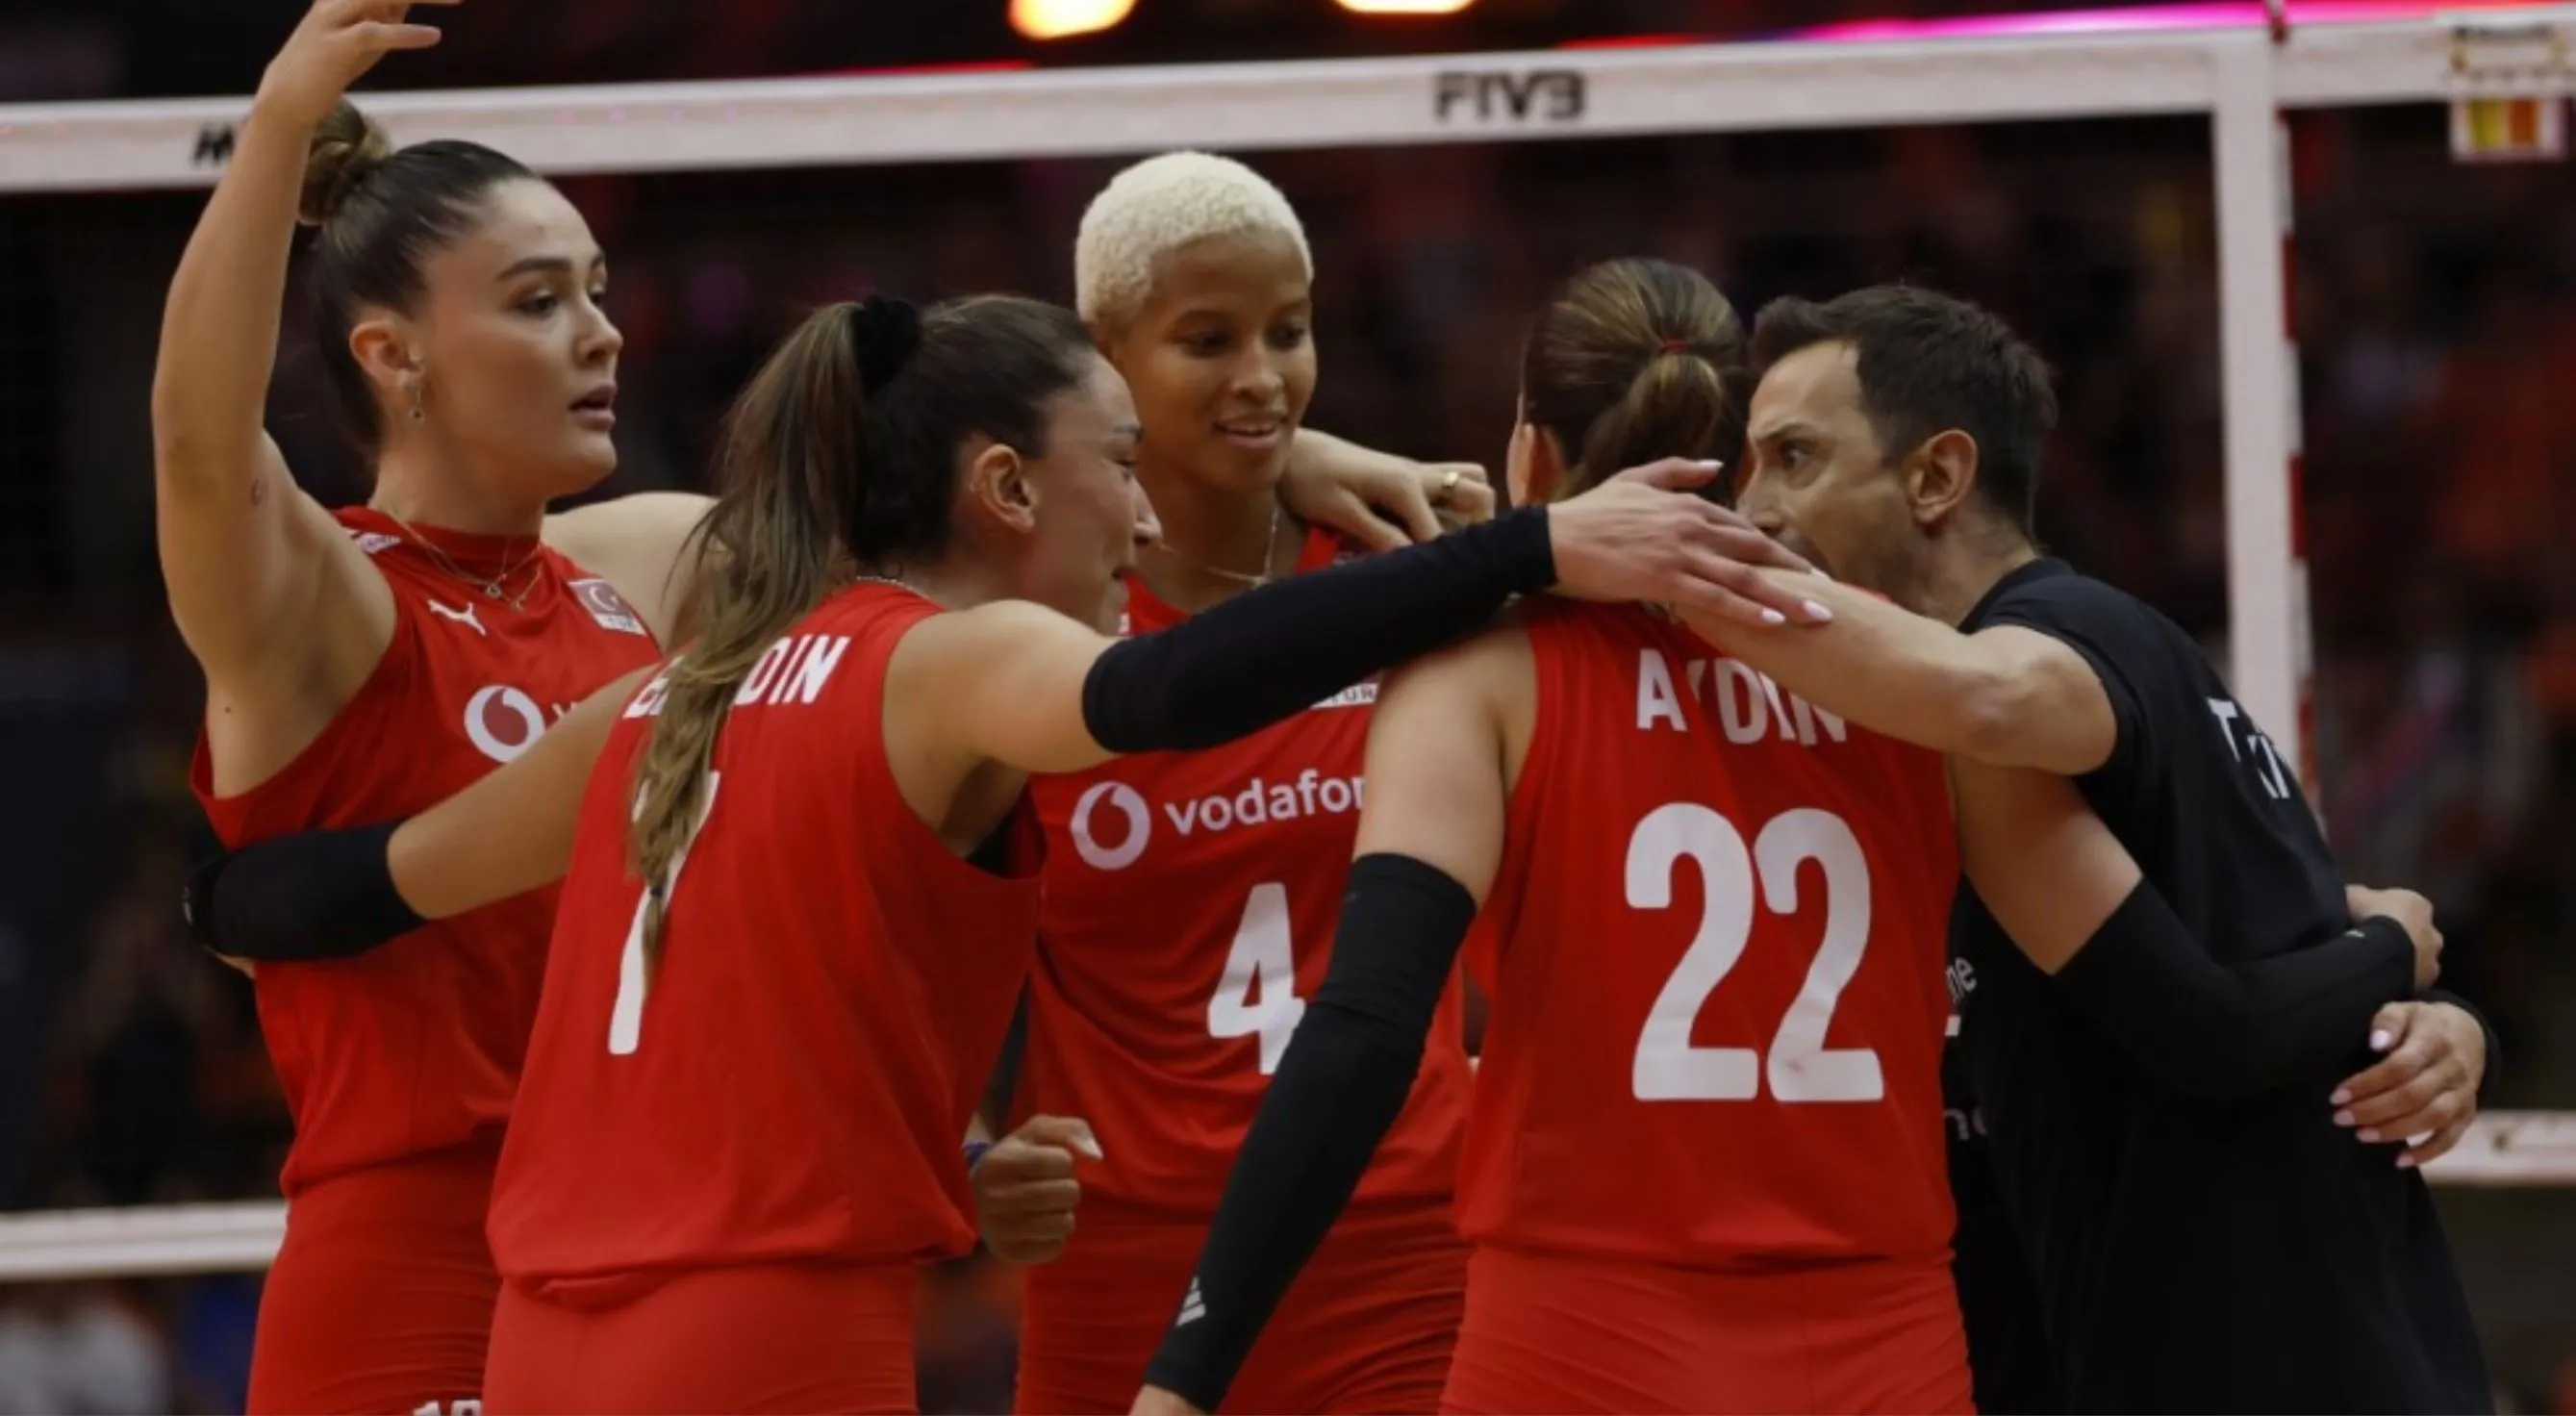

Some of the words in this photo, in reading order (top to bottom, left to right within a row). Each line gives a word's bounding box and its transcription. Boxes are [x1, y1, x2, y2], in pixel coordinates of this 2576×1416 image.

[1434, 69, 1586, 121] FIVB
[1164, 769, 1365, 836] vodafo
[1207, 881, 1306, 1075] 4
[1624, 801, 1884, 1102] 22
